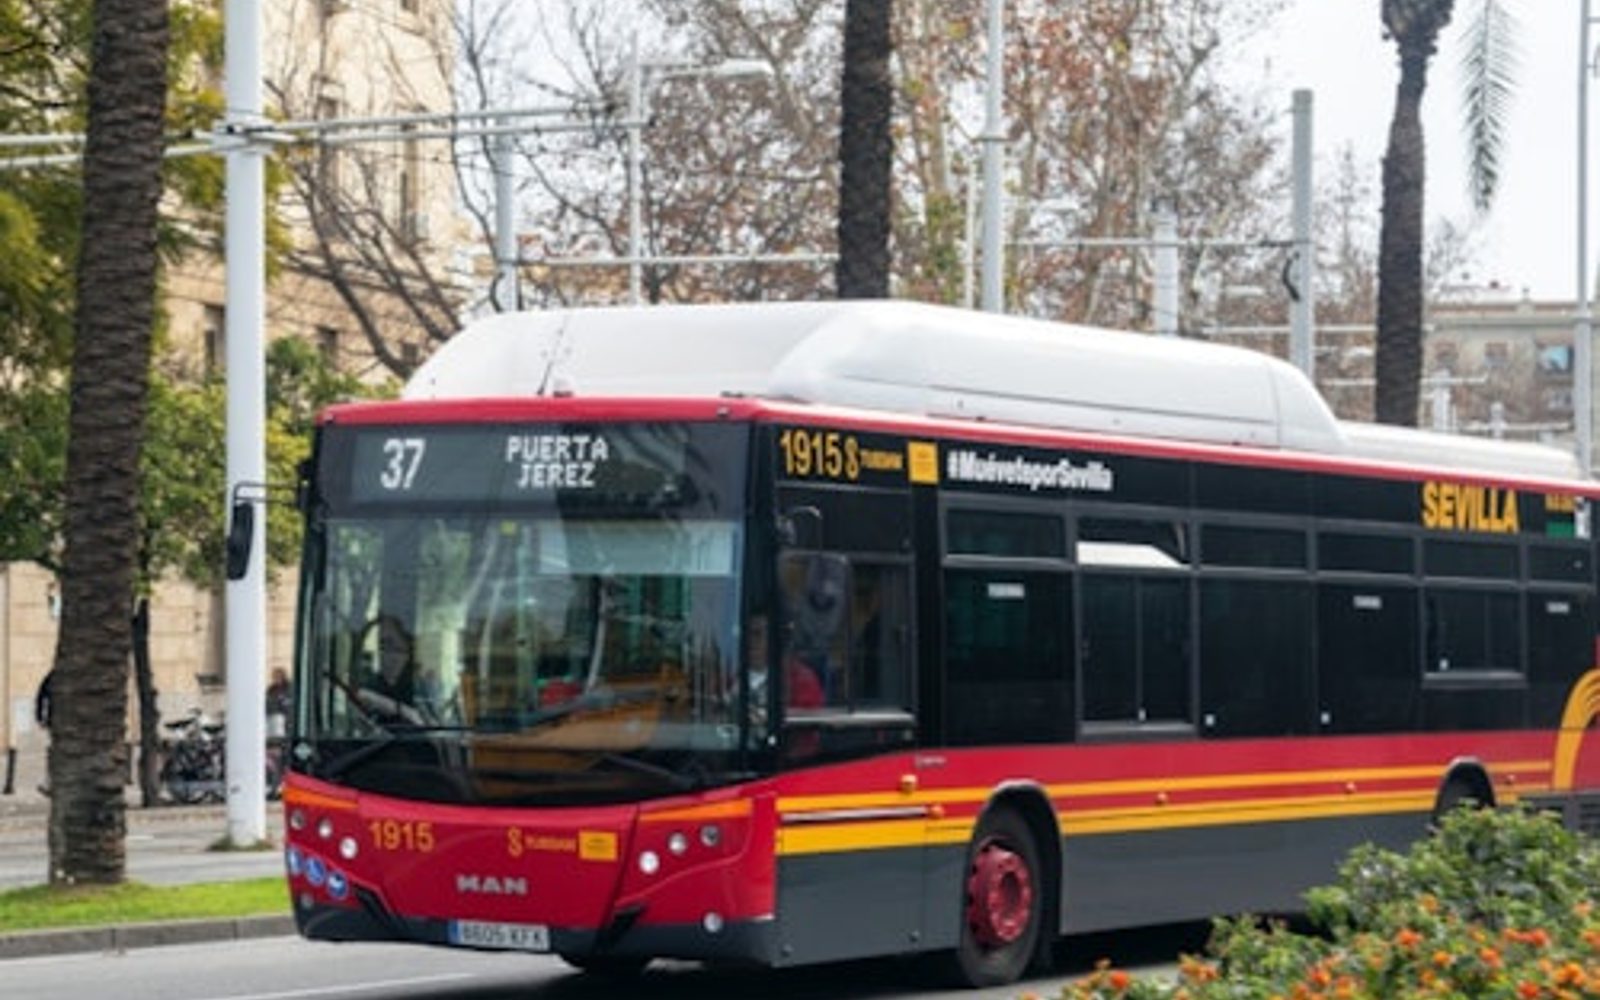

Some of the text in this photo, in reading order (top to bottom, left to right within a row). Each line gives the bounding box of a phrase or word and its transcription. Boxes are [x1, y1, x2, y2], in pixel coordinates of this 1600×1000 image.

[379, 437, 425, 489] 37
[506, 435, 609, 462] PUERTA
[780, 430, 843, 478] 1915
[518, 463, 596, 489] JEREZ
[1421, 480, 1520, 534] SEVILLA
[368, 820, 434, 853] 1915
[456, 873, 528, 896] MAN
